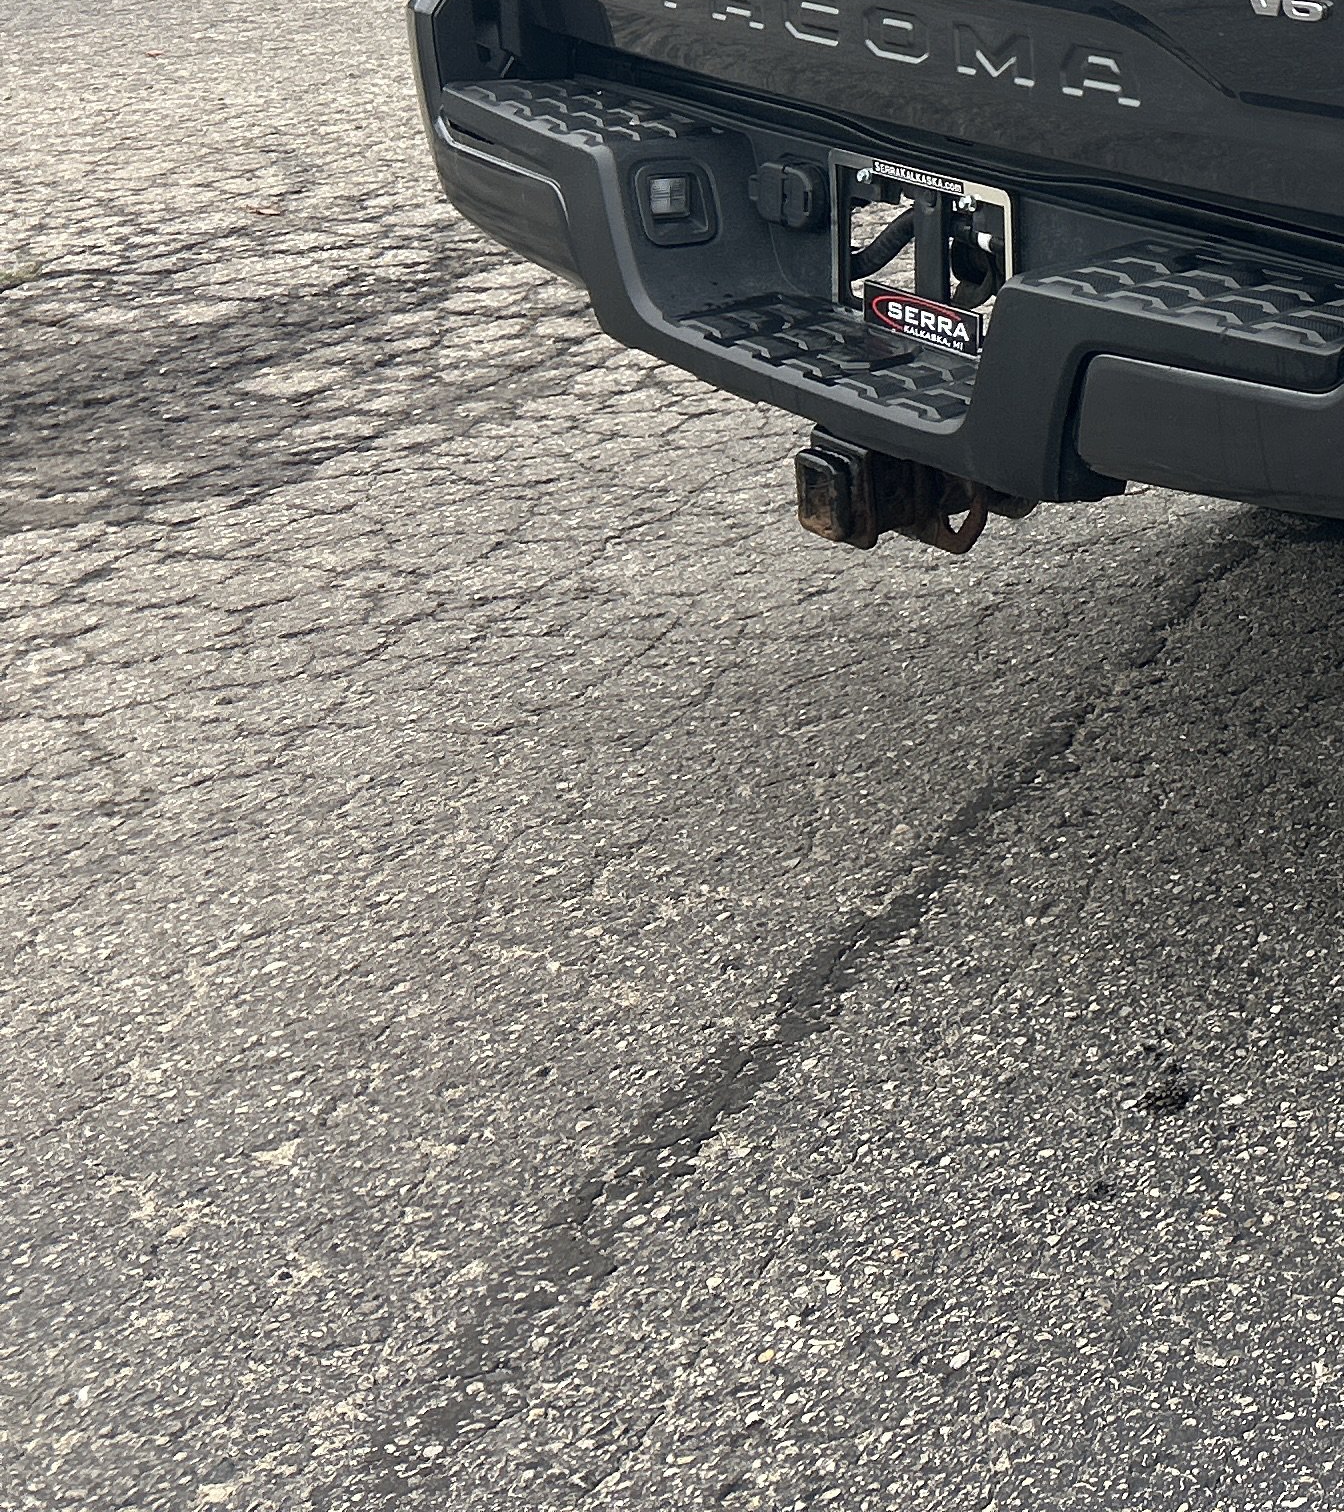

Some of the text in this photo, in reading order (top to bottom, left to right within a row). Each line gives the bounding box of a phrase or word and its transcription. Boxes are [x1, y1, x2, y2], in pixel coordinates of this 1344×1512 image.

[874, 161, 962, 192] SERRAKALKASKA.com
[887, 301, 969, 341] SERRA
[904, 325, 964, 350] KALKASKA, MI
